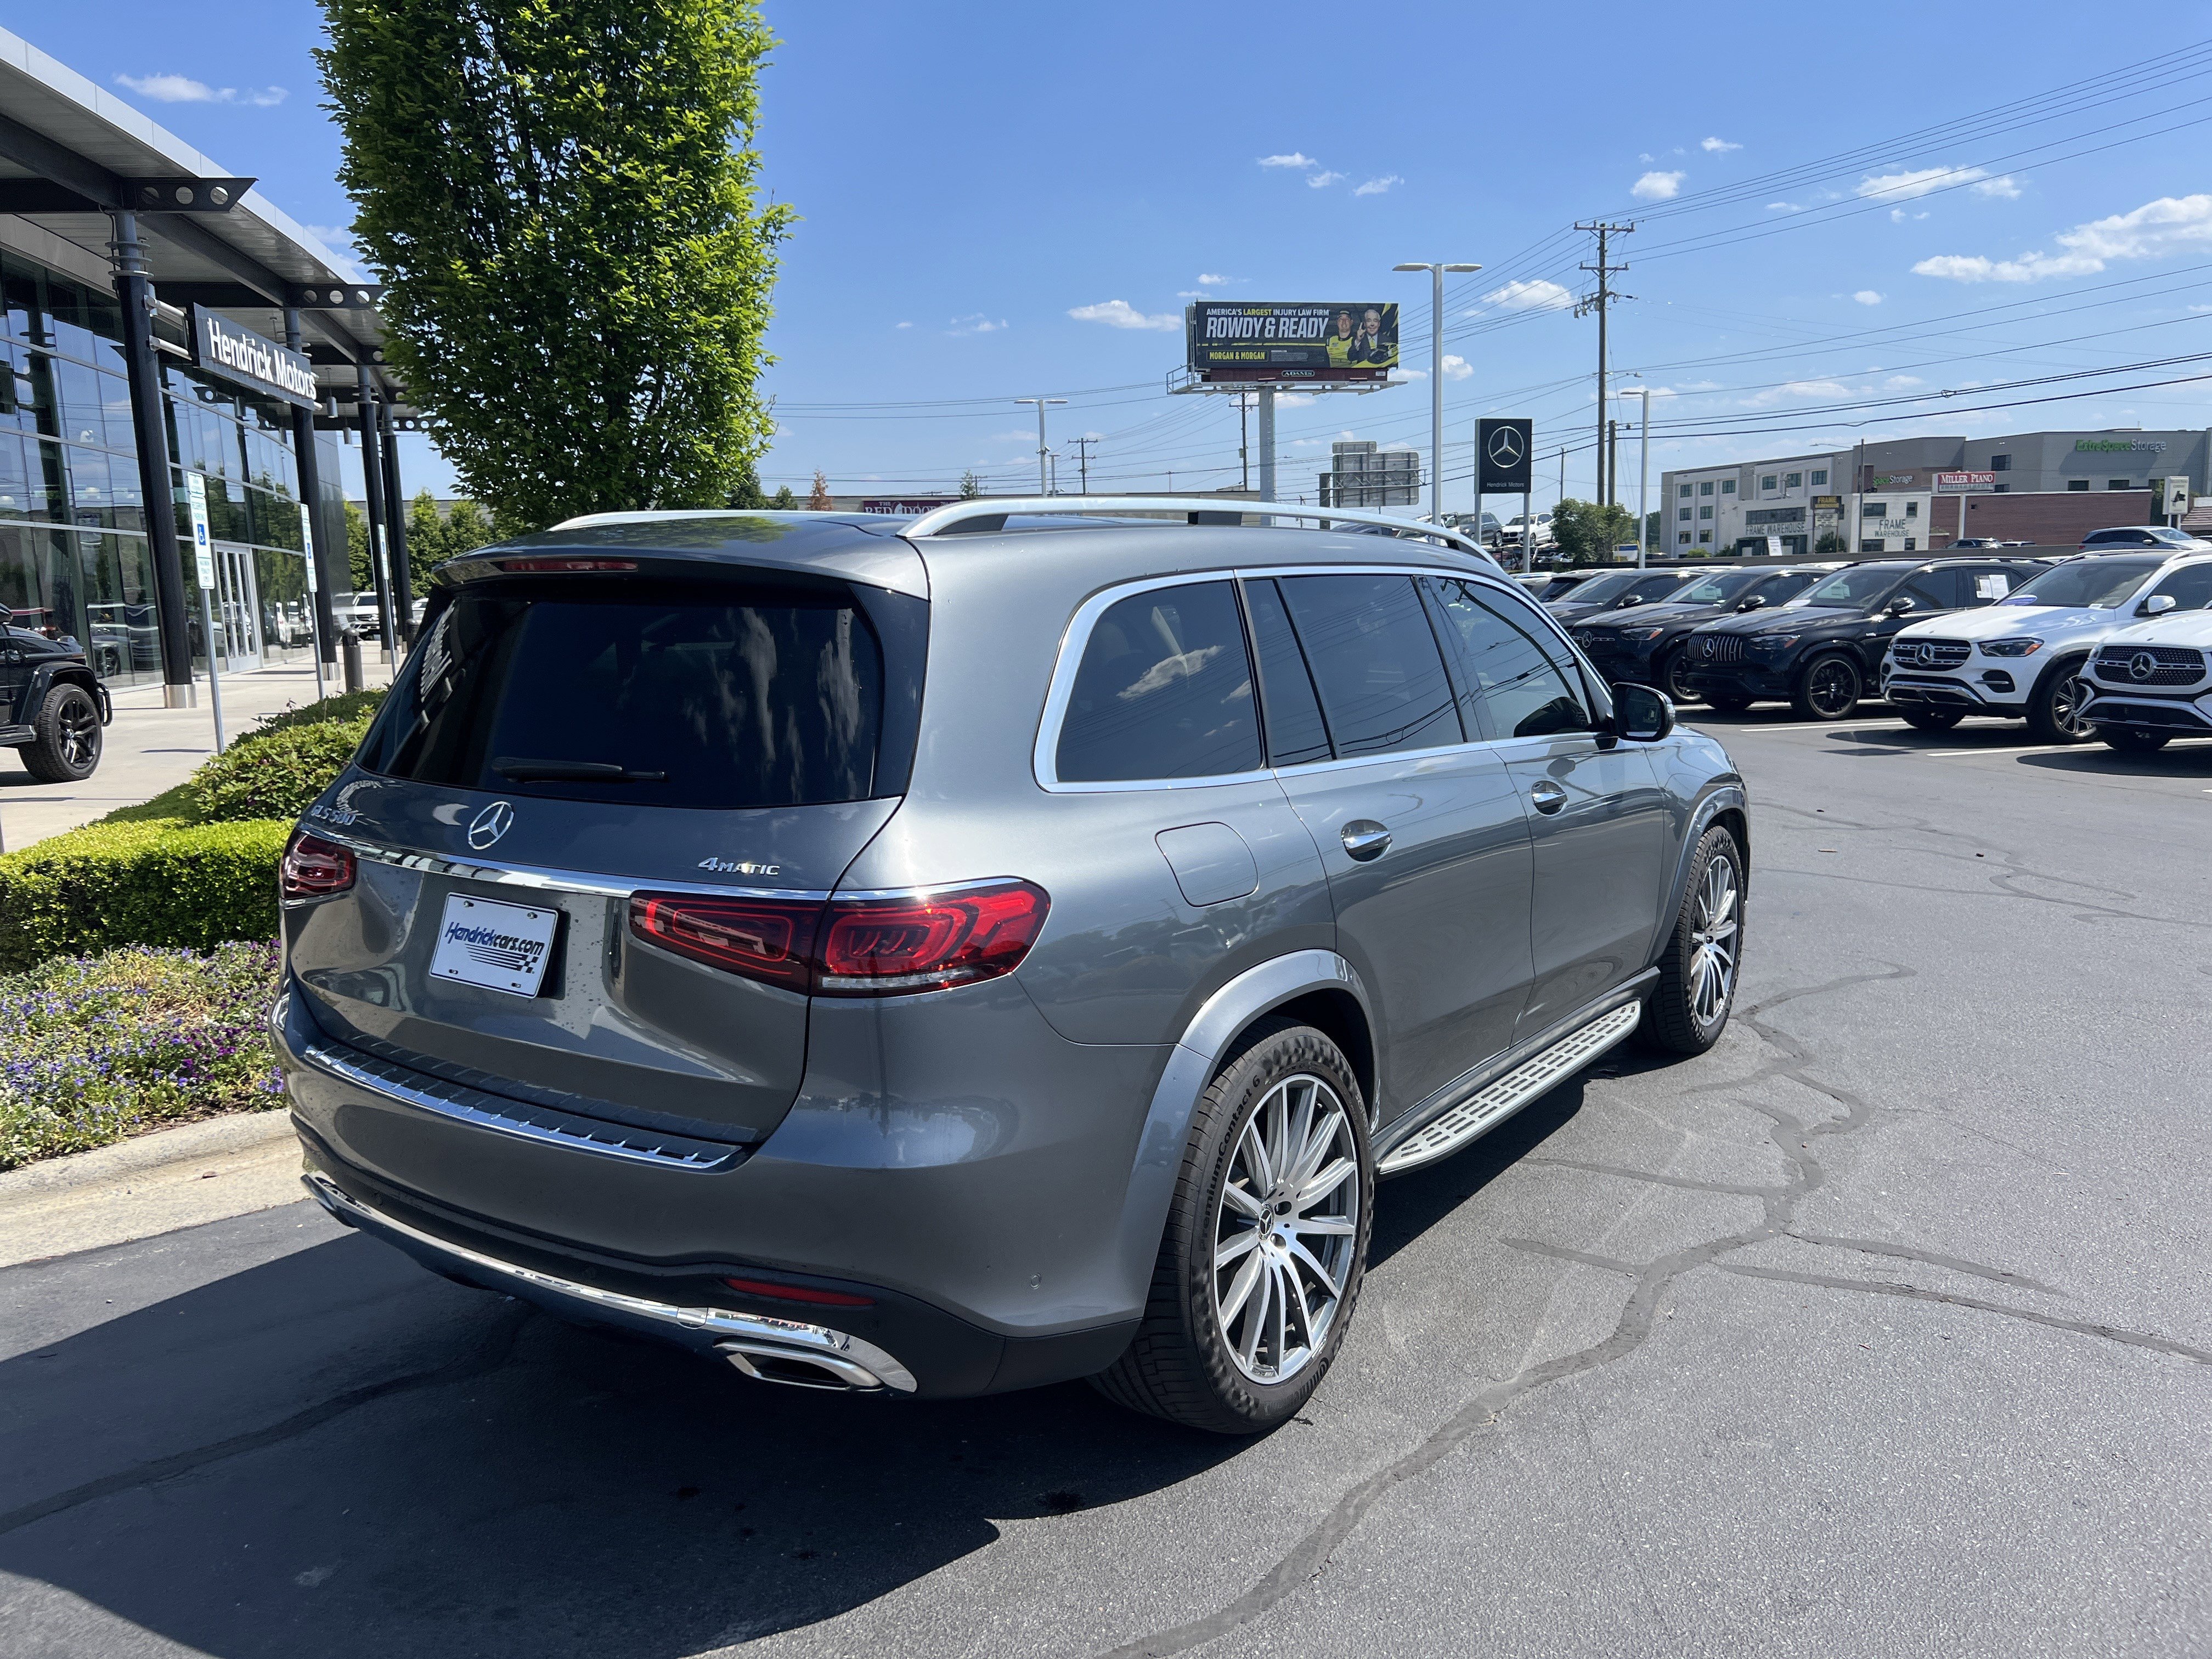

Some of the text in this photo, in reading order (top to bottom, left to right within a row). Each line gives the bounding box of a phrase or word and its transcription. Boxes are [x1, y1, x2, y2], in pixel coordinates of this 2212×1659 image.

[1206, 317, 1329, 338] ROWDY & READY
[207, 317, 317, 400] Hendrick Motors
[1209, 351, 1234, 360] MORGAN
[1240, 352, 1265, 360] MORGAN
[1940, 473, 1994, 483] MILLER PIANO
[901, 506, 939, 515] DOO
[1746, 522, 1805, 535] FRAME WAREHOUSE
[1879, 518, 1906, 531] FRAME
[698, 857, 781, 876] 4MATIC
[444, 921, 545, 956] Hendrickcars.com
[1199, 1074, 1261, 1252] PremiumContact 6
